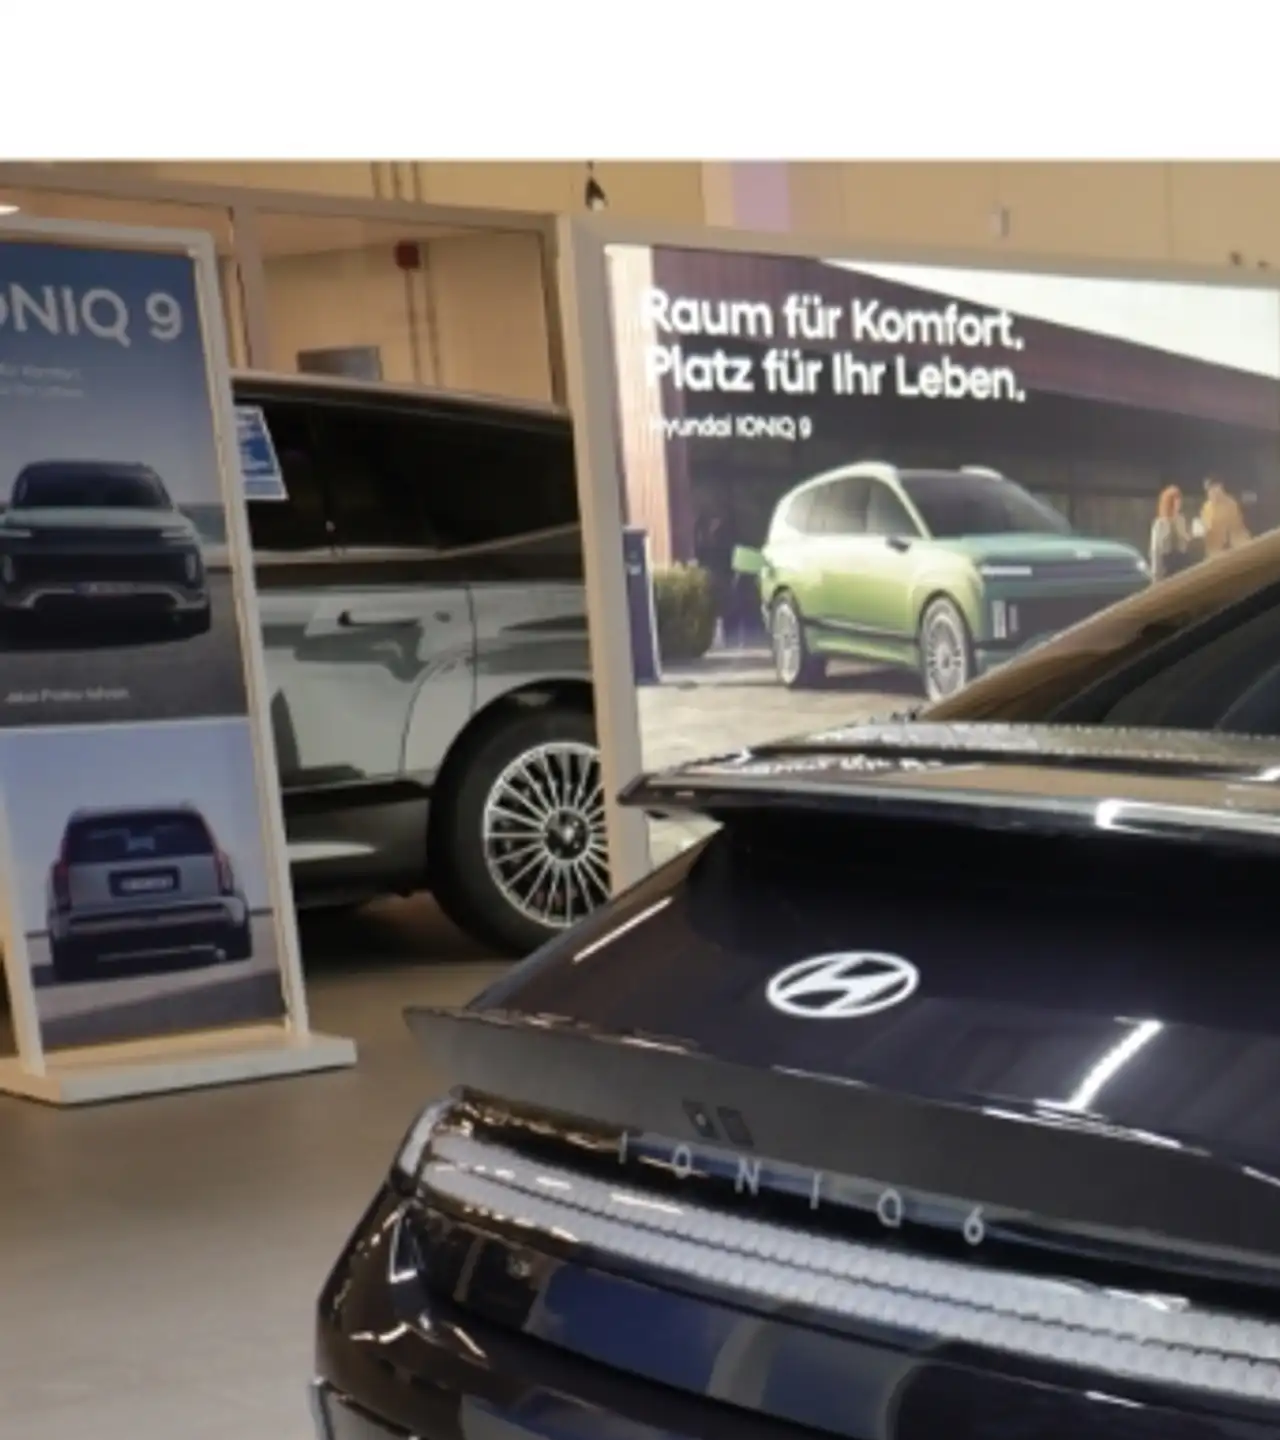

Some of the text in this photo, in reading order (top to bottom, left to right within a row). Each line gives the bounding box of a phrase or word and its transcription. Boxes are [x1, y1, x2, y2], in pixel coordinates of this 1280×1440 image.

[145, 292, 183, 342] 9
[641, 288, 1025, 351] Raum für Komfort.
[645, 345, 1026, 402] Platz für Ihr Leben.
[735, 415, 796, 441] IONIQ
